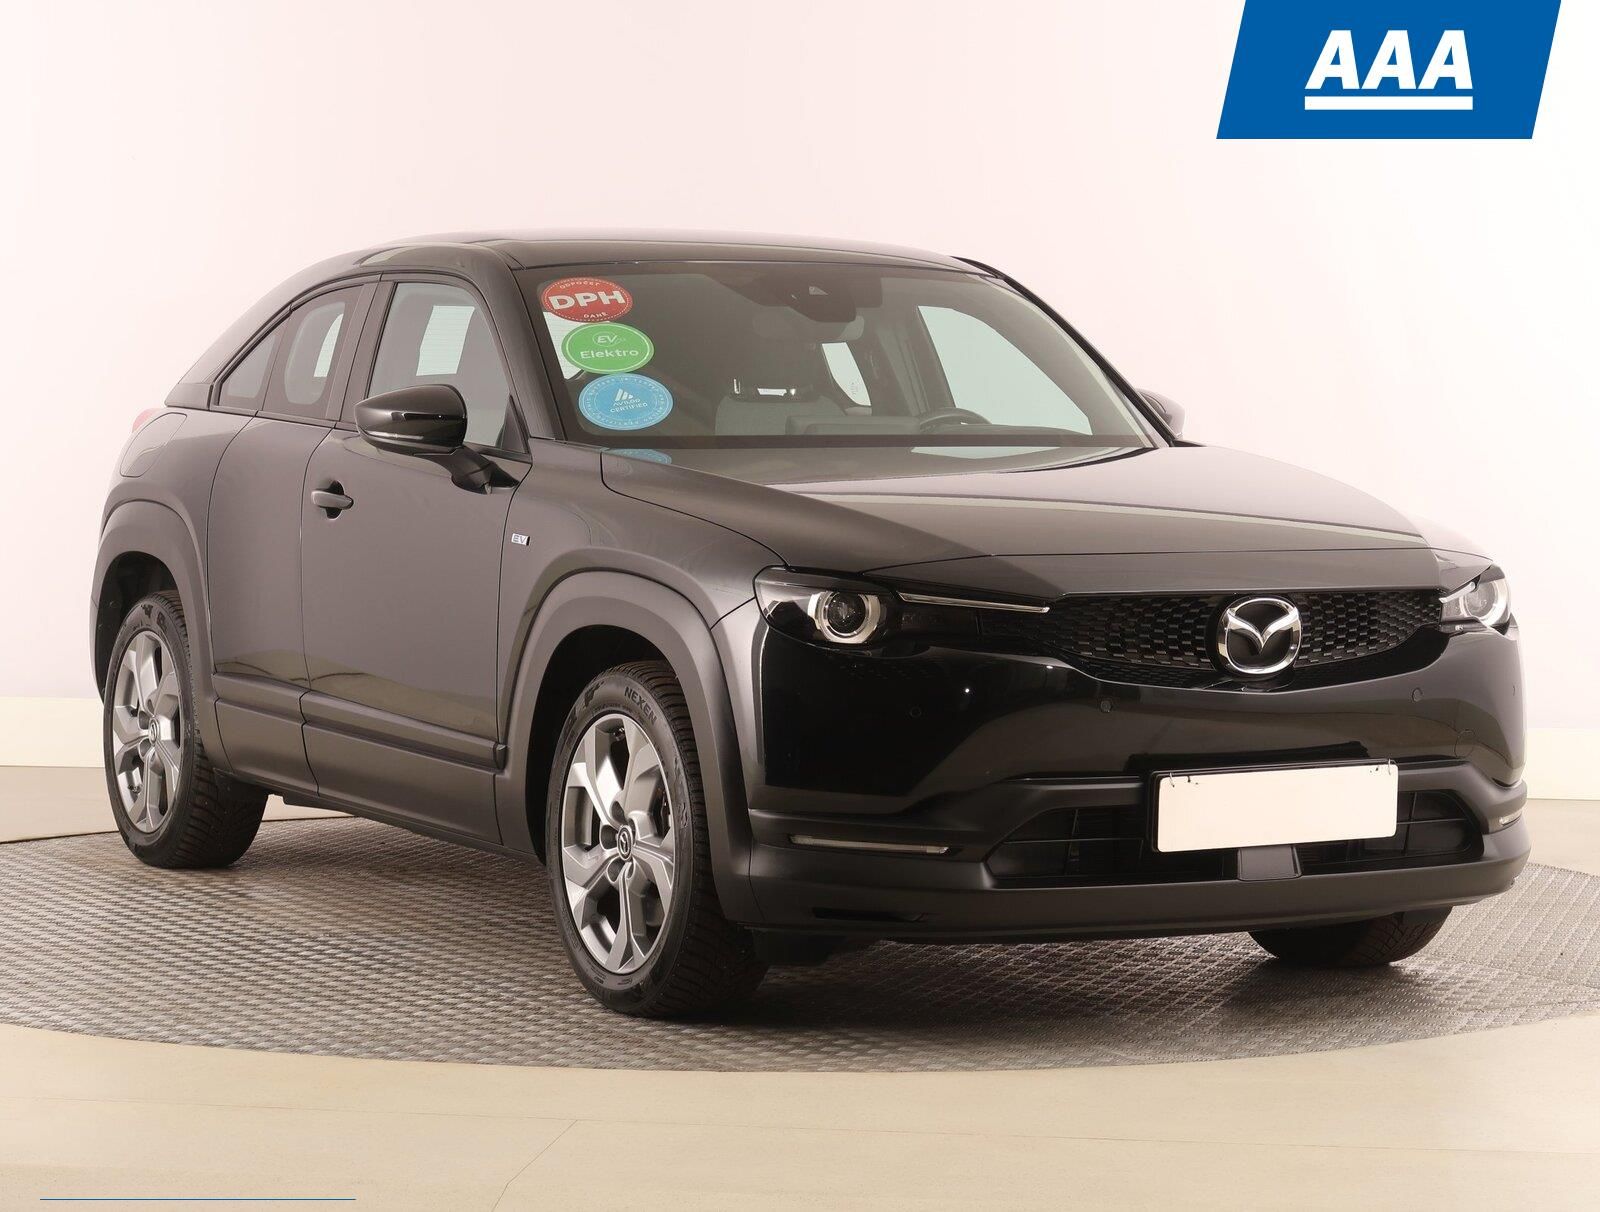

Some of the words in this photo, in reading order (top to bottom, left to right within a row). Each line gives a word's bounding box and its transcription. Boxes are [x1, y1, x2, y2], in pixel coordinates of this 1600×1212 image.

[548, 290, 625, 310] DPH
[597, 334, 618, 344] EV
[580, 350, 640, 359] Elektro
[610, 402, 648, 413] CERTIFIED
[513, 534, 527, 544] EV
[624, 686, 658, 726] NEXEN
